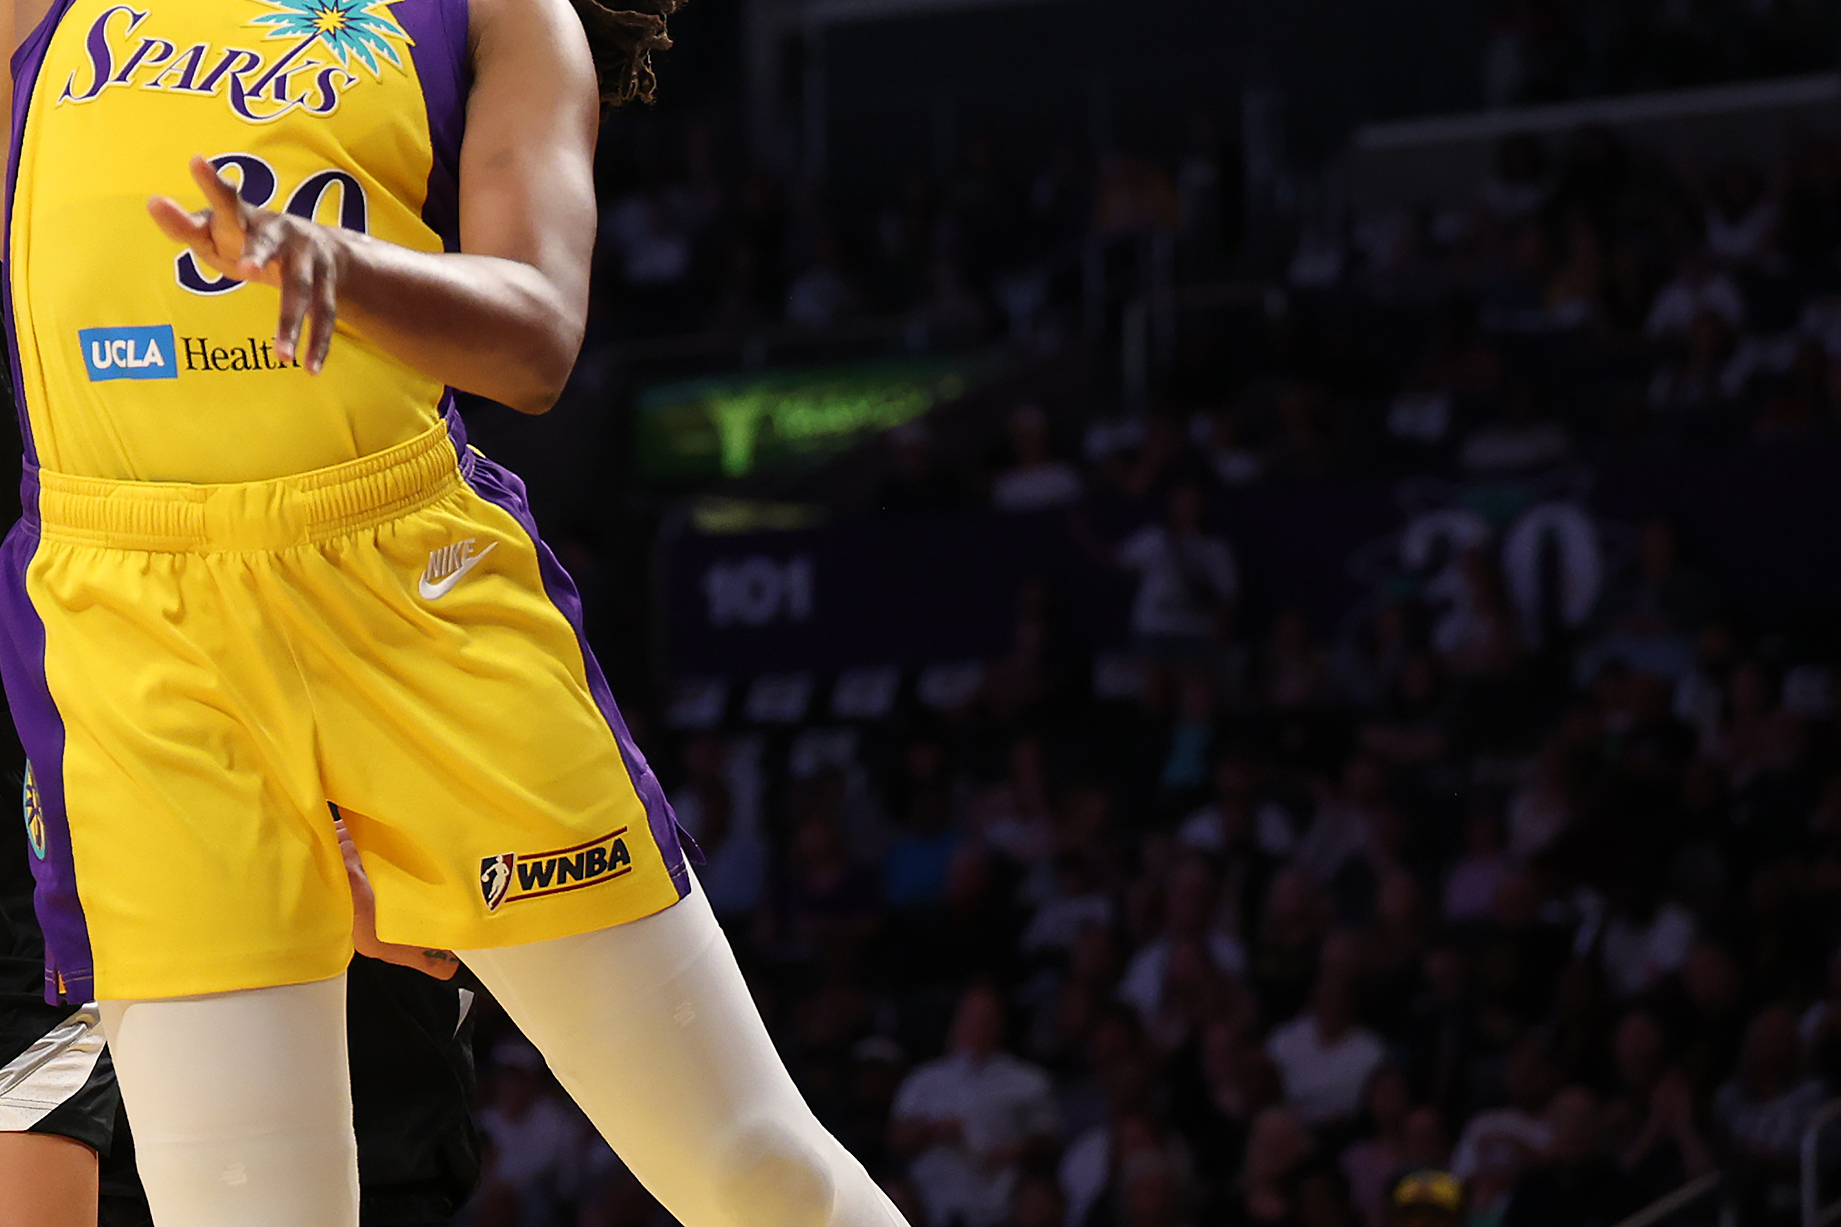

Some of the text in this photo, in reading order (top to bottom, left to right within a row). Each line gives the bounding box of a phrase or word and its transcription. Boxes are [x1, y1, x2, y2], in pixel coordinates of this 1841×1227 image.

[91, 336, 302, 373] UCLA Healt
[516, 837, 632, 892] WNBA
